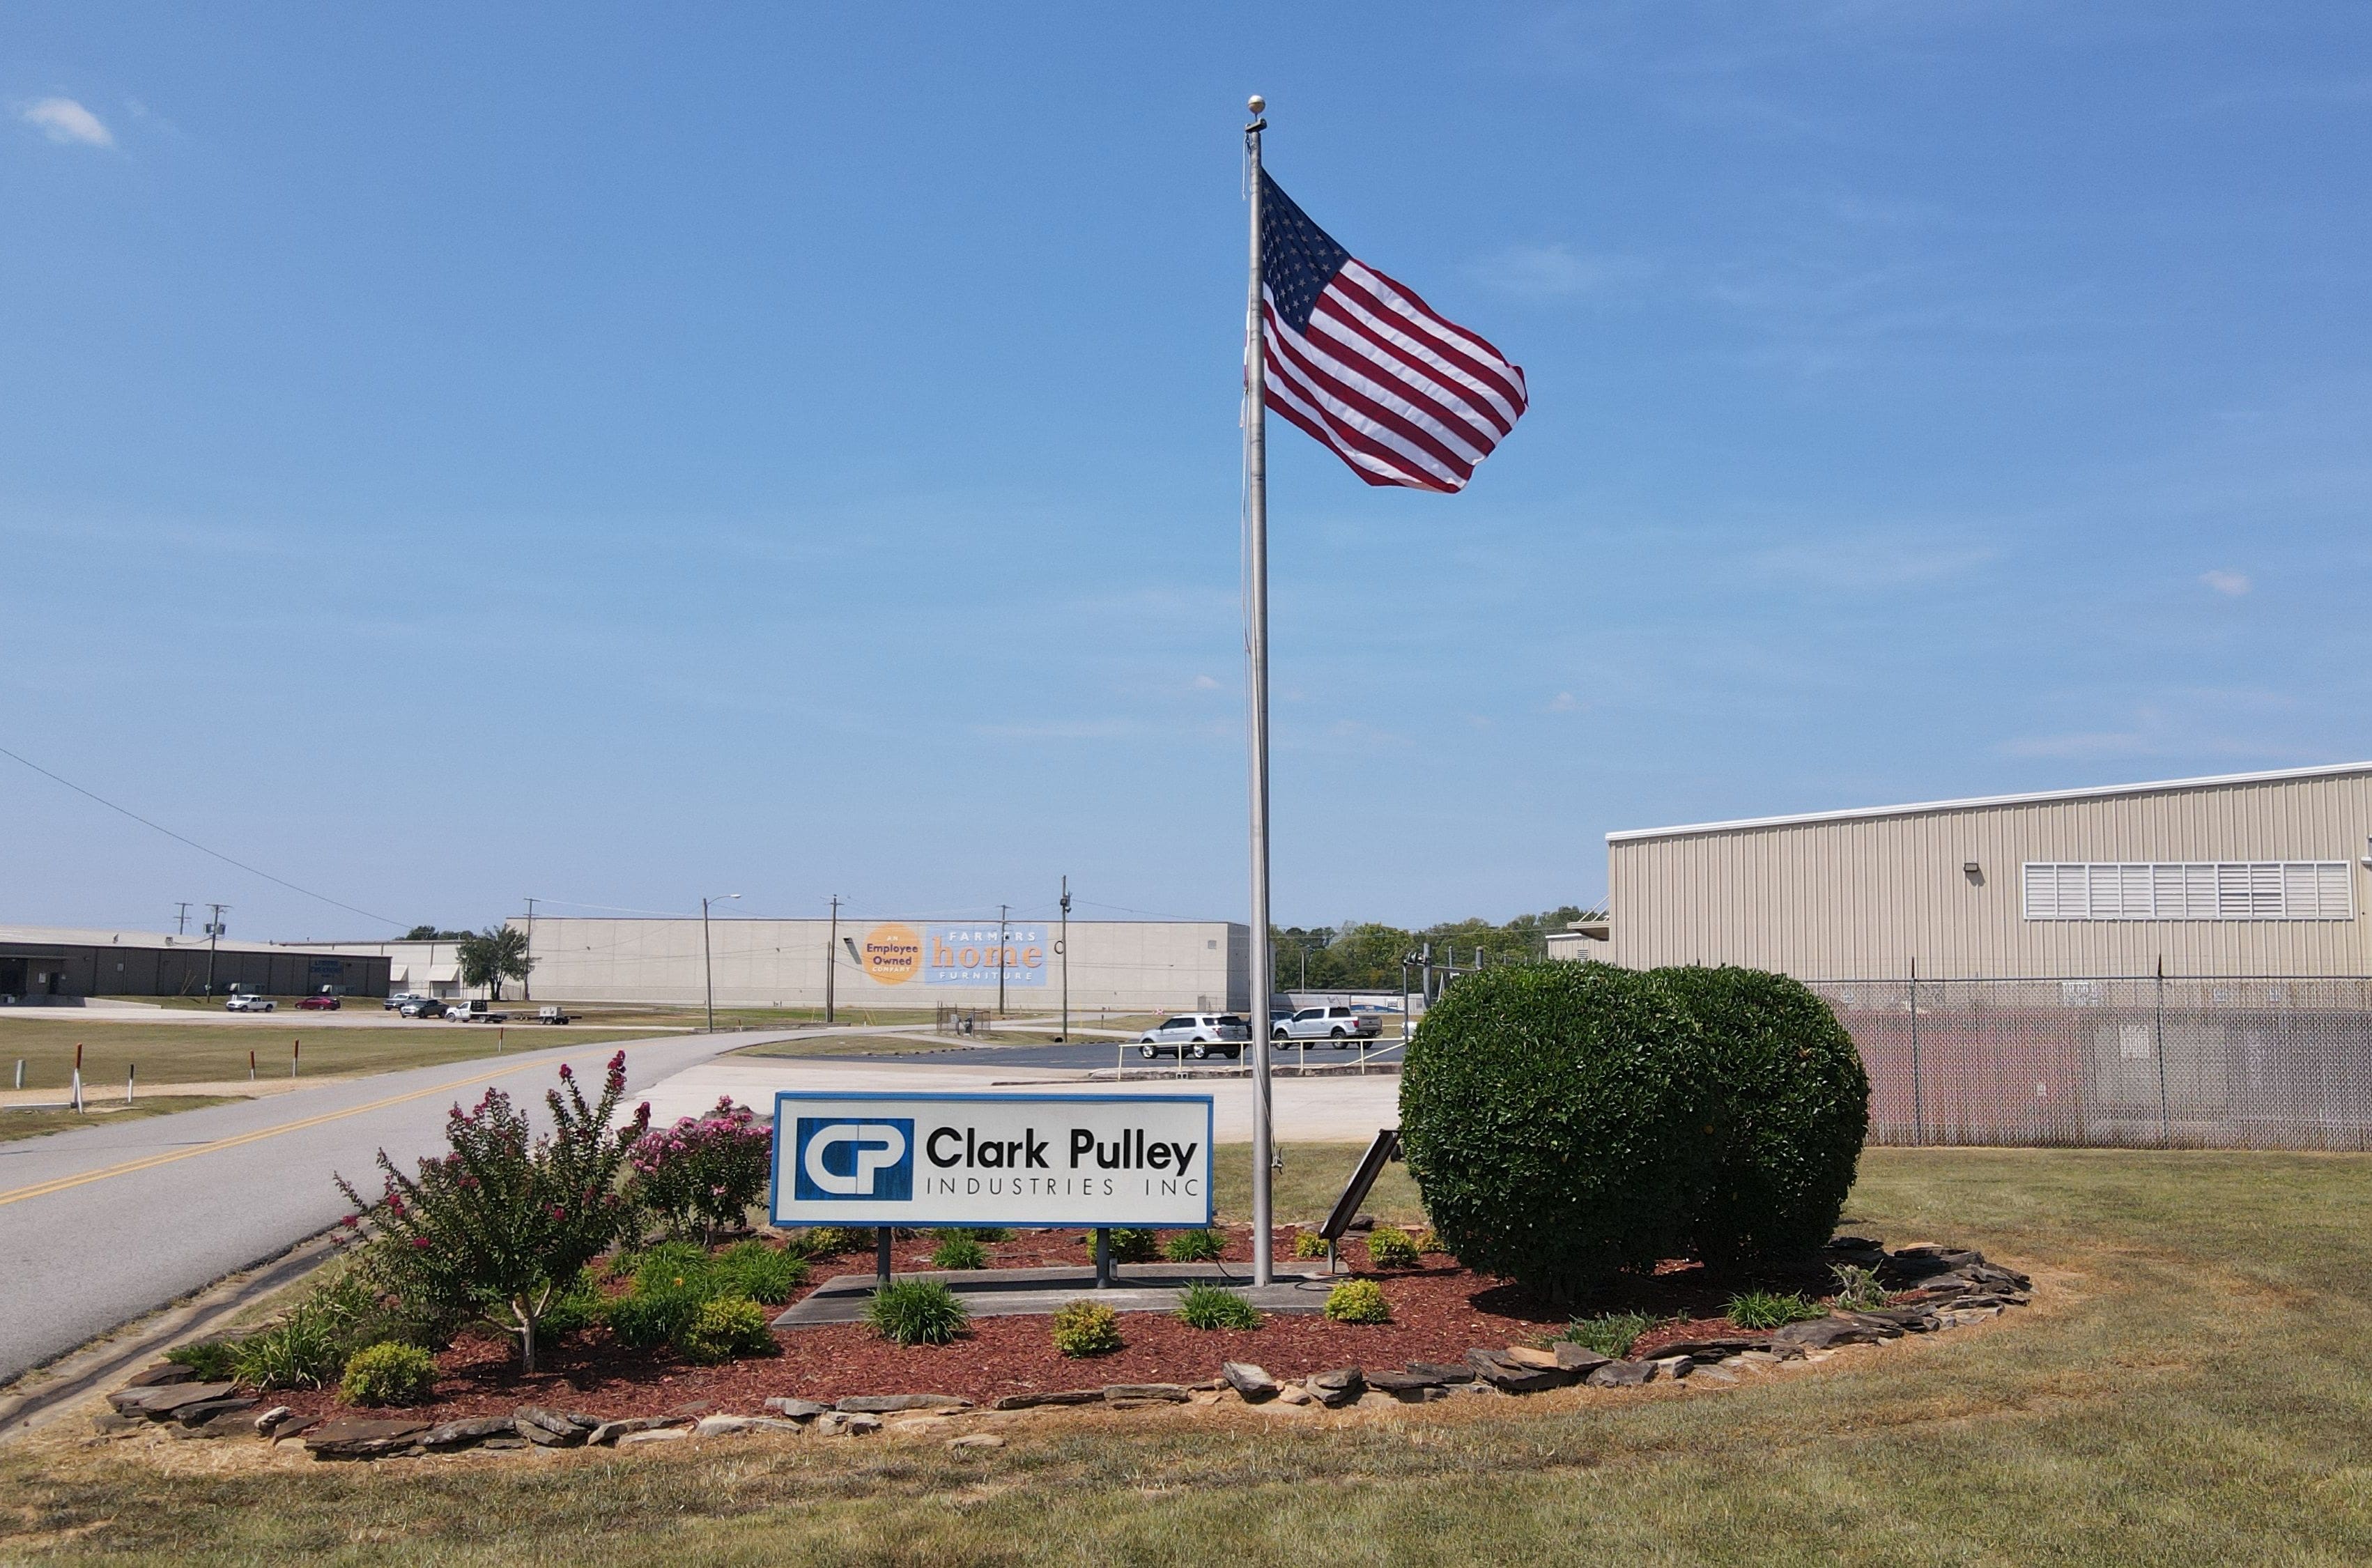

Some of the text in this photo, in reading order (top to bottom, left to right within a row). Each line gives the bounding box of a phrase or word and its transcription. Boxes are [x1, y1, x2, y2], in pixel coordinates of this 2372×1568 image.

[948, 932, 1035, 941] FARMERS
[867, 943, 918, 955] Employee
[932, 936, 1042, 968] home
[873, 955, 911, 965] Owned
[939, 971, 1033, 980] FURNITURE
[926, 1126, 1198, 1176] Clark Pulley
[805, 1124, 906, 1195] CP
[927, 1177, 1199, 1196] INDUSTRIES INC
